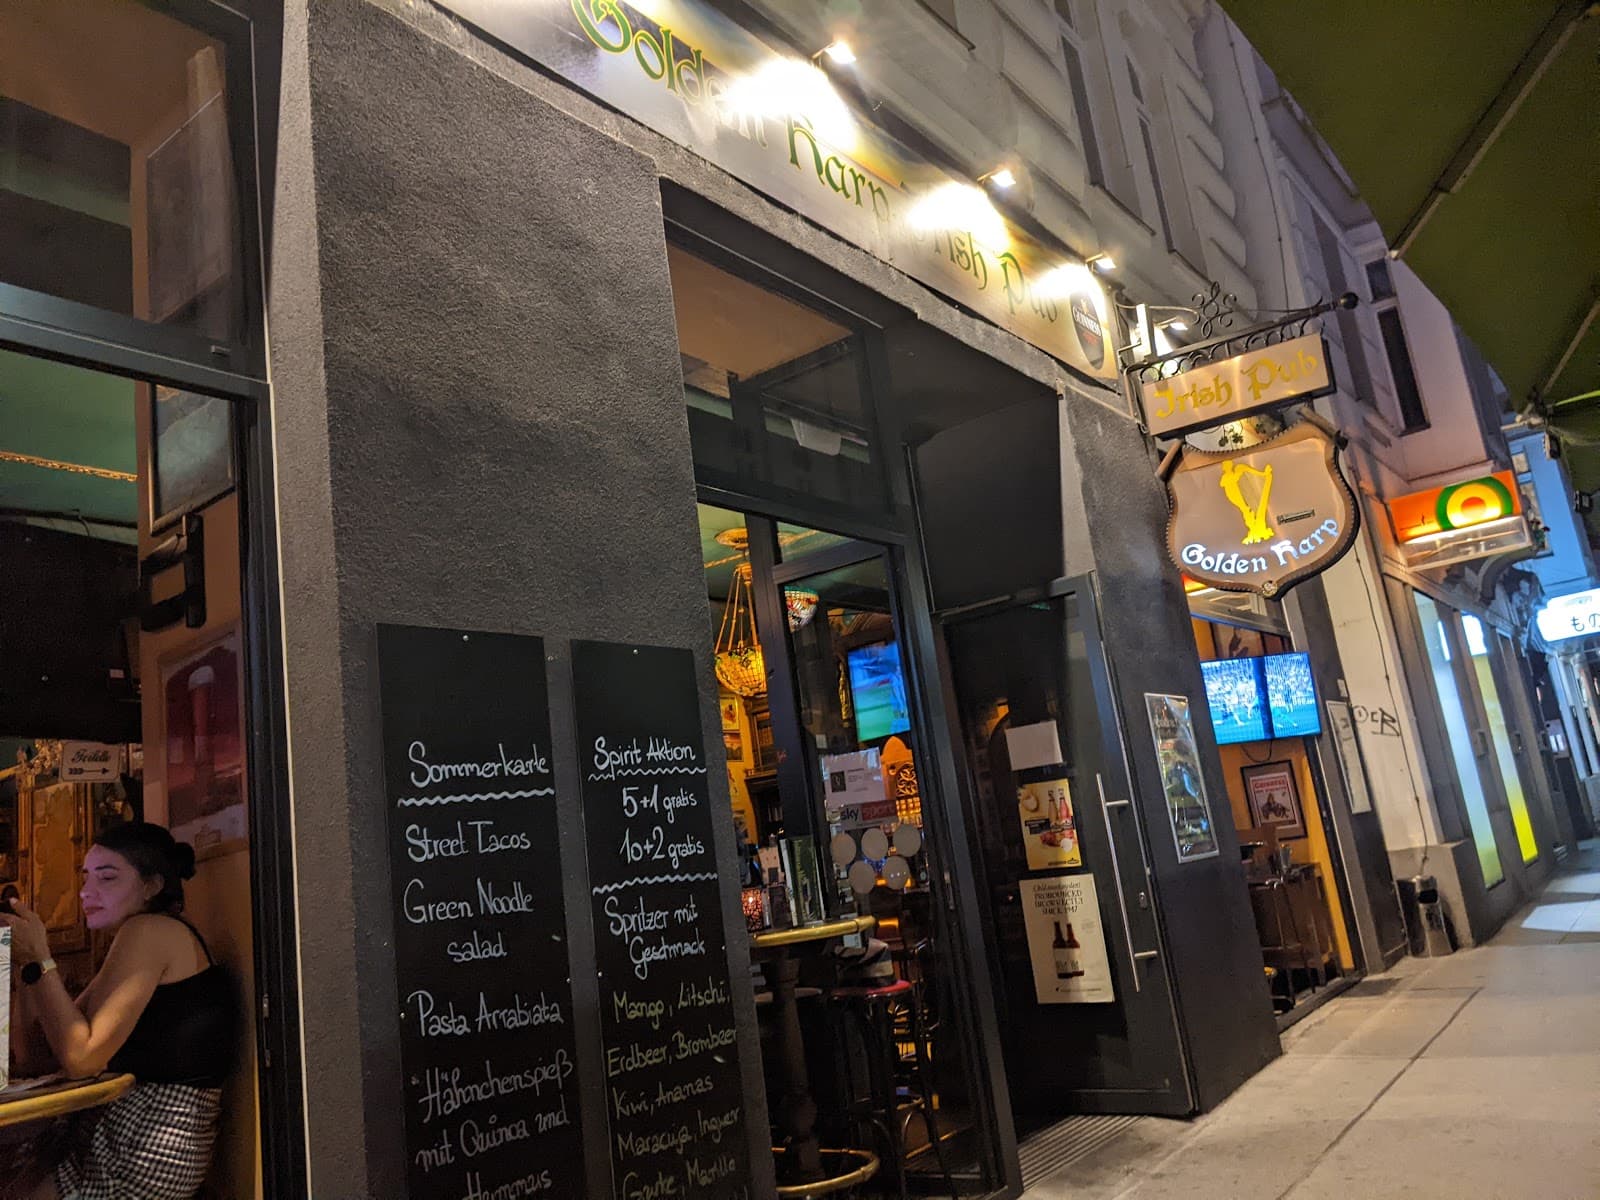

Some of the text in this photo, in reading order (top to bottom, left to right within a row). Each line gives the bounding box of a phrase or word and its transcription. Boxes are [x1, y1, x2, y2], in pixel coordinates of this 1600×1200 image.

[1153, 350, 1319, 419] Irish Pub
[1181, 518, 1339, 574] Golden Harp
[407, 740, 550, 788] Sommerkarte
[593, 735, 697, 781] Spirit Aktion
[622, 783, 698, 824] 5+1 gratis
[840, 808, 859, 822] sky
[404, 820, 532, 863] Street Tacos
[619, 825, 706, 870] 10+2 gratis
[403, 877, 535, 924] Green Noodle
[603, 894, 699, 945] Spritzer mit
[446, 930, 507, 964] salad
[629, 928, 707, 980] Geschmack
[406, 989, 564, 1037] Pasta Arrabiata
[671, 1023, 738, 1061] Brombeer
[418, 1049, 574, 1123] Hähnchenspieß
[655, 1074, 714, 1107] Ananas
[414, 1093, 571, 1173] mit Quinoa und
